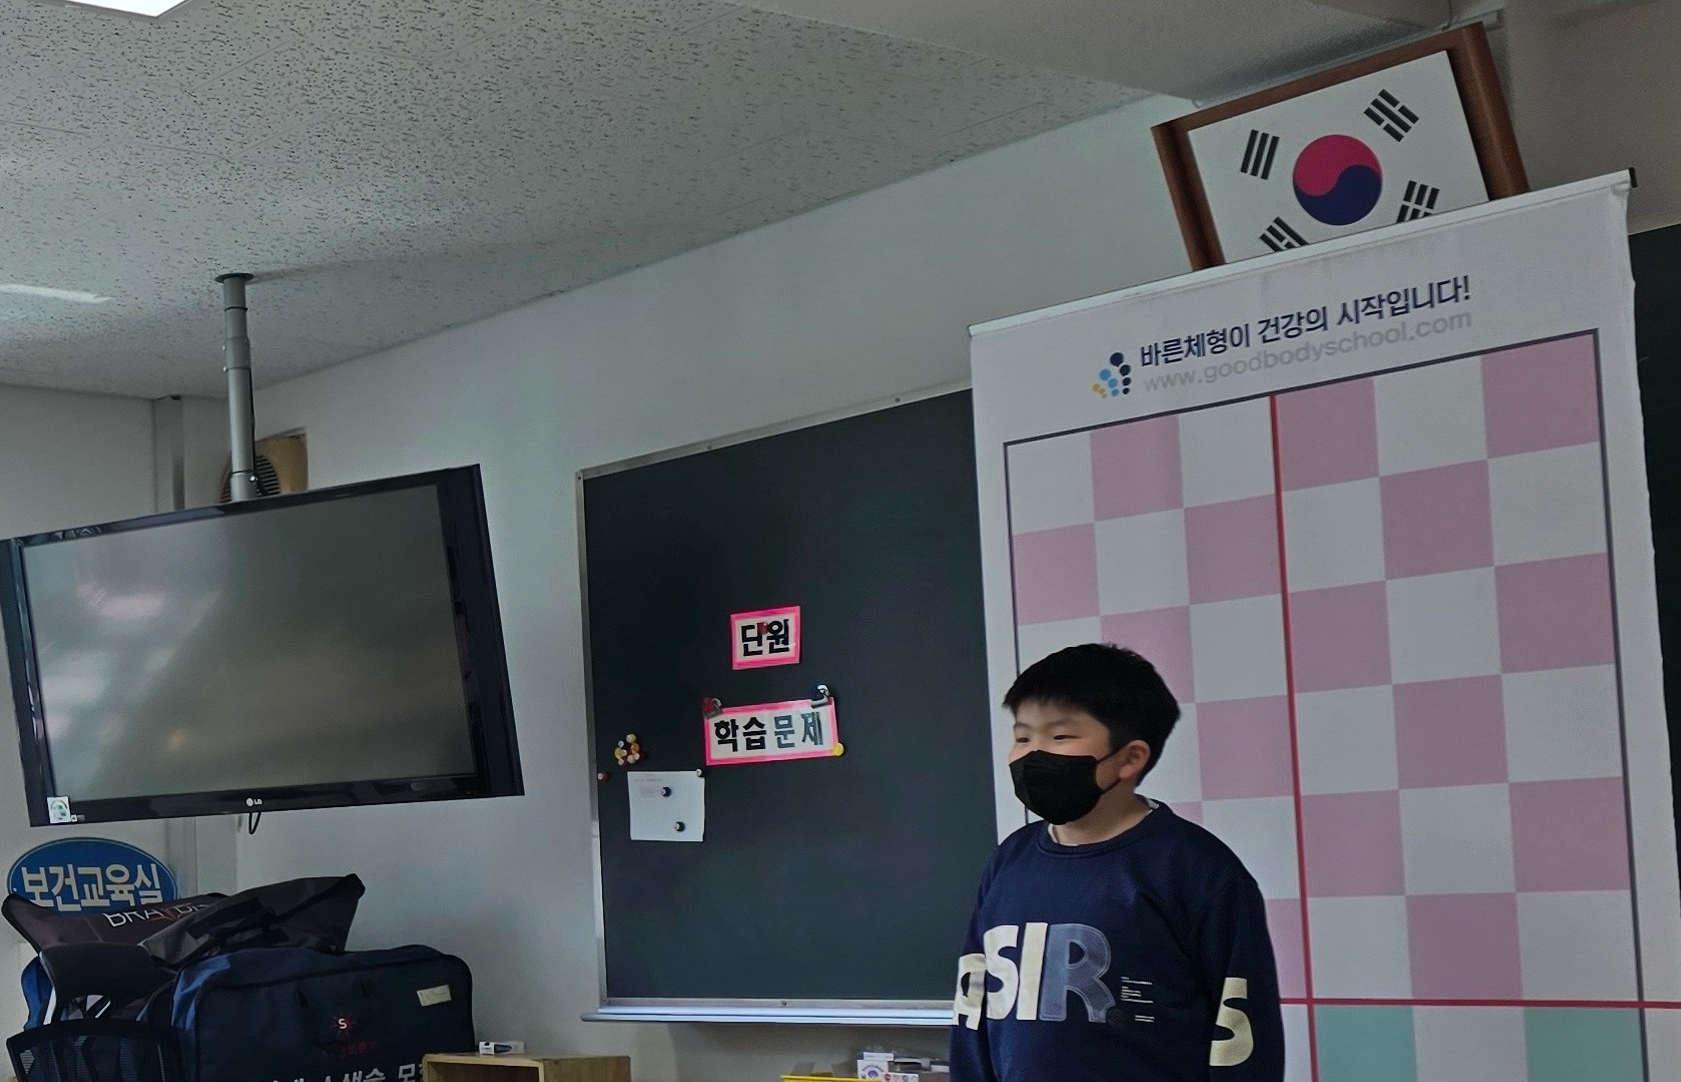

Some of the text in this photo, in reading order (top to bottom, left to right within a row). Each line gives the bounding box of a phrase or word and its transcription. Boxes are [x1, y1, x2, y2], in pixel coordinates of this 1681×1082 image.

[1139, 275, 1472, 368] 바른체형이 건강의 시작입니다!
[1143, 310, 1472, 393] www.goodbodyschool.com
[741, 618, 791, 657] 단원
[21, 863, 163, 912] 보건교육실
